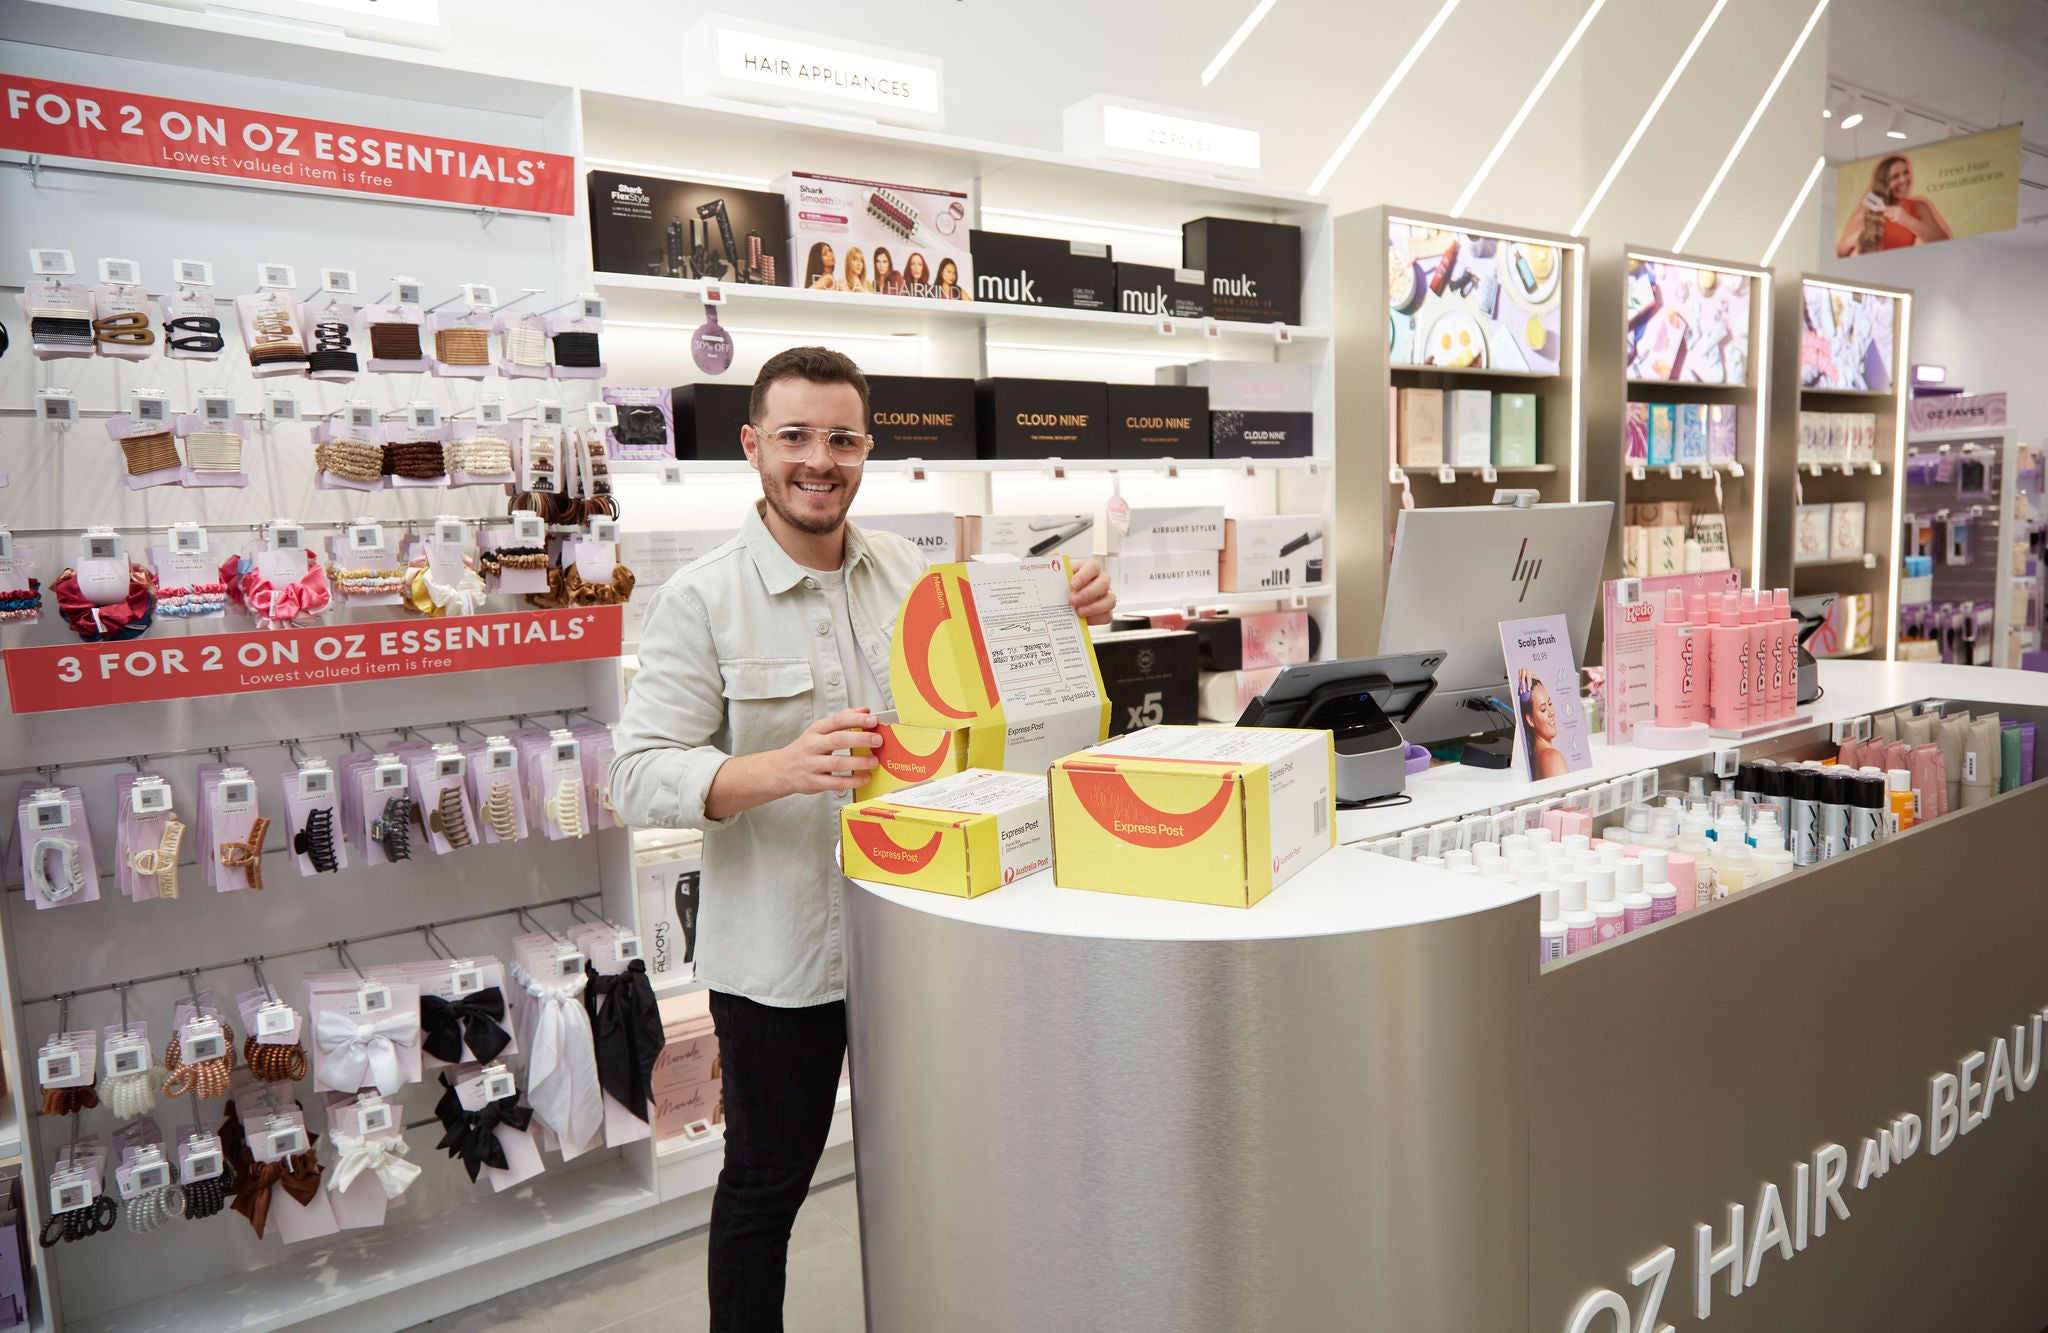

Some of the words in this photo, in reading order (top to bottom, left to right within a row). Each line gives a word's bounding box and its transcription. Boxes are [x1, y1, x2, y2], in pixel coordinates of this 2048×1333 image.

[744, 53, 791, 77] HAIR
[798, 64, 910, 98] APPLIANCES
[7, 88, 106, 131] FOR
[119, 105, 144, 136] 2
[160, 110, 227, 147] ON
[243, 122, 300, 157] OZ
[162, 146, 228, 169] Lowest
[233, 156, 294, 176] valued
[299, 164, 337, 181] item
[342, 169, 355, 183] is
[360, 170, 393, 188] free
[1938, 166, 1964, 178] Free
[1967, 159, 1992, 172] Hair
[618, 183, 643, 194] Shark
[800, 184, 824, 195] Shark
[1926, 171, 2004, 193] Consultations
[611, 191, 650, 204] FlexStyle
[811, 274, 848, 291] FOR
[852, 280, 882, 295] ALL
[887, 281, 961, 300] HAIRKIND
[873, 412, 919, 426] CLOUD
[922, 413, 953, 427] NINE
[1016, 413, 1057, 427] CLOUD
[1060, 414, 1087, 428] NINE
[1927, 411, 1945, 421] OZ
[1947, 407, 1984, 418] FAVES
[1126, 417, 1163, 429] CLOUD
[1165, 418, 1190, 429] NINE
[1243, 431, 1268, 440] CLOUD
[1269, 432, 1285, 440] NINE
[1152, 525, 1189, 534] AIRBURST
[1149, 571, 1184, 580] AIRBURST
[933, 576, 945, 608] Medium
[1625, 601, 1655, 623] Redo
[1518, 637, 1537, 648] Scalp
[1537, 634, 1556, 646] Brush
[57, 656, 82, 683] 3
[101, 648, 189, 680] FOR
[202, 646, 224, 671] 2
[238, 639, 299, 668] ON
[313, 633, 366, 661] OZ
[240, 667, 300, 686] Lowest
[305, 662, 361, 682] valued
[366, 660, 401, 675] item
[405, 658, 418, 671] is
[422, 655, 453, 670] free
[1061, 694, 1074, 703] Post
[1074, 690, 1096, 701] Express
[1126, 692, 1163, 729] x5
[1008, 725, 1030, 736] Express
[1030, 722, 1044, 731] Post
[887, 760, 911, 772] Express
[912, 763, 927, 774] Post
[1001, 826, 1024, 841] Express
[1024, 819, 1039, 832] Post
[1114, 821, 1157, 836] Express
[1159, 824, 1184, 837] Post
[873, 848, 901, 860] Express
[902, 850, 919, 863] Post
[1015, 862, 1036, 877] Australia
[1037, 857, 1049, 869] Post
[655, 927, 666, 973] ALYON
[1695, 1143, 1851, 1320] HAIR
[1855, 1111, 1922, 1190] AND
[1929, 1005, 2048, 1157] BEAU
